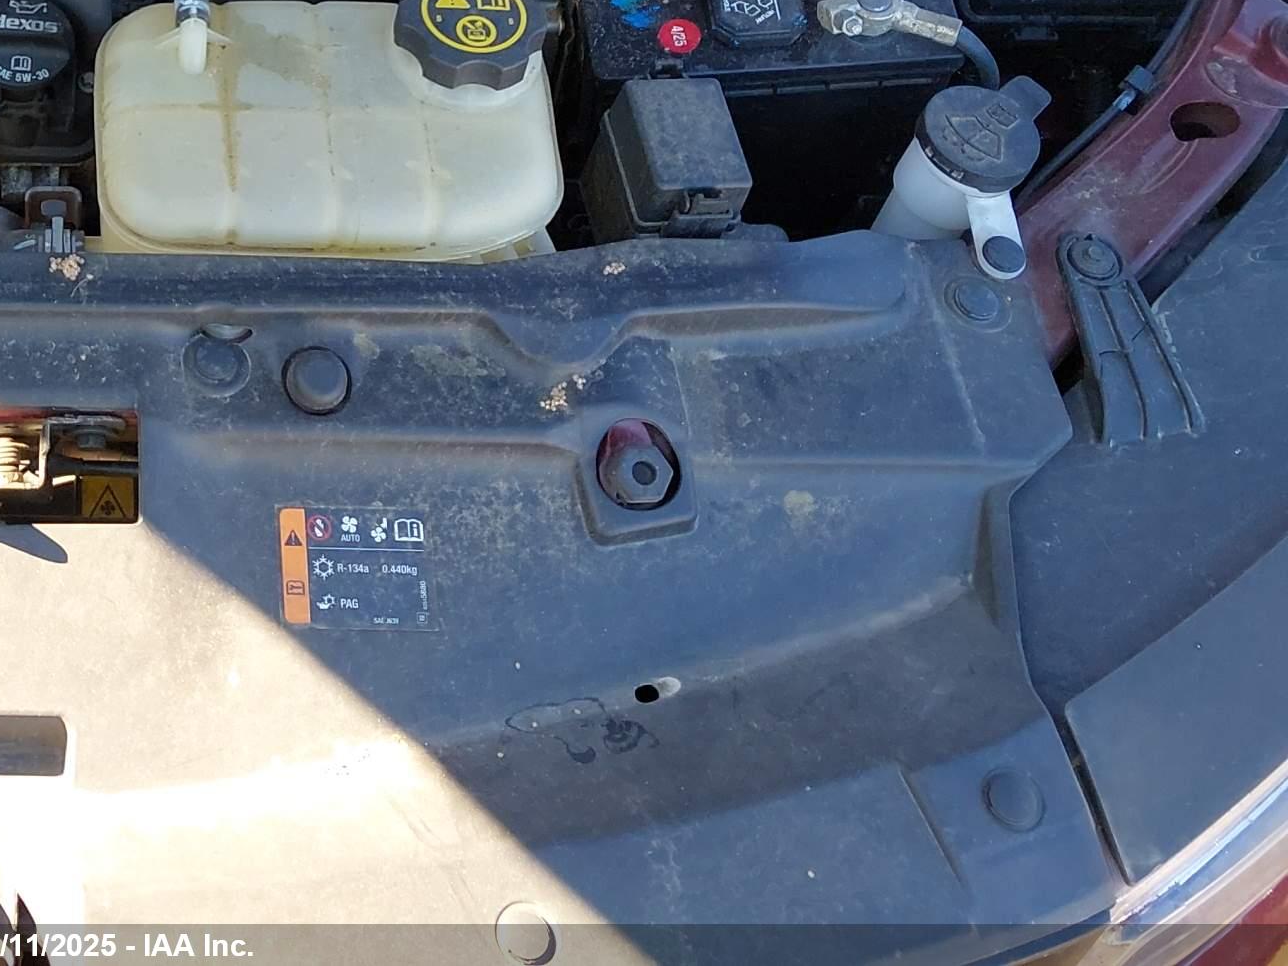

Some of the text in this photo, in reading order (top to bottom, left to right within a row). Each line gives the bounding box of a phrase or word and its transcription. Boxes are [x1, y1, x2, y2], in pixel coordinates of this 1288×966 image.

[669, 25, 687, 46] 4/25
[15, 69, 49, 83] 5W-30
[341, 534, 360, 543] AUTO
[337, 564, 418, 576] R-134a 0.440kg
[340, 598, 359, 609] PAG
